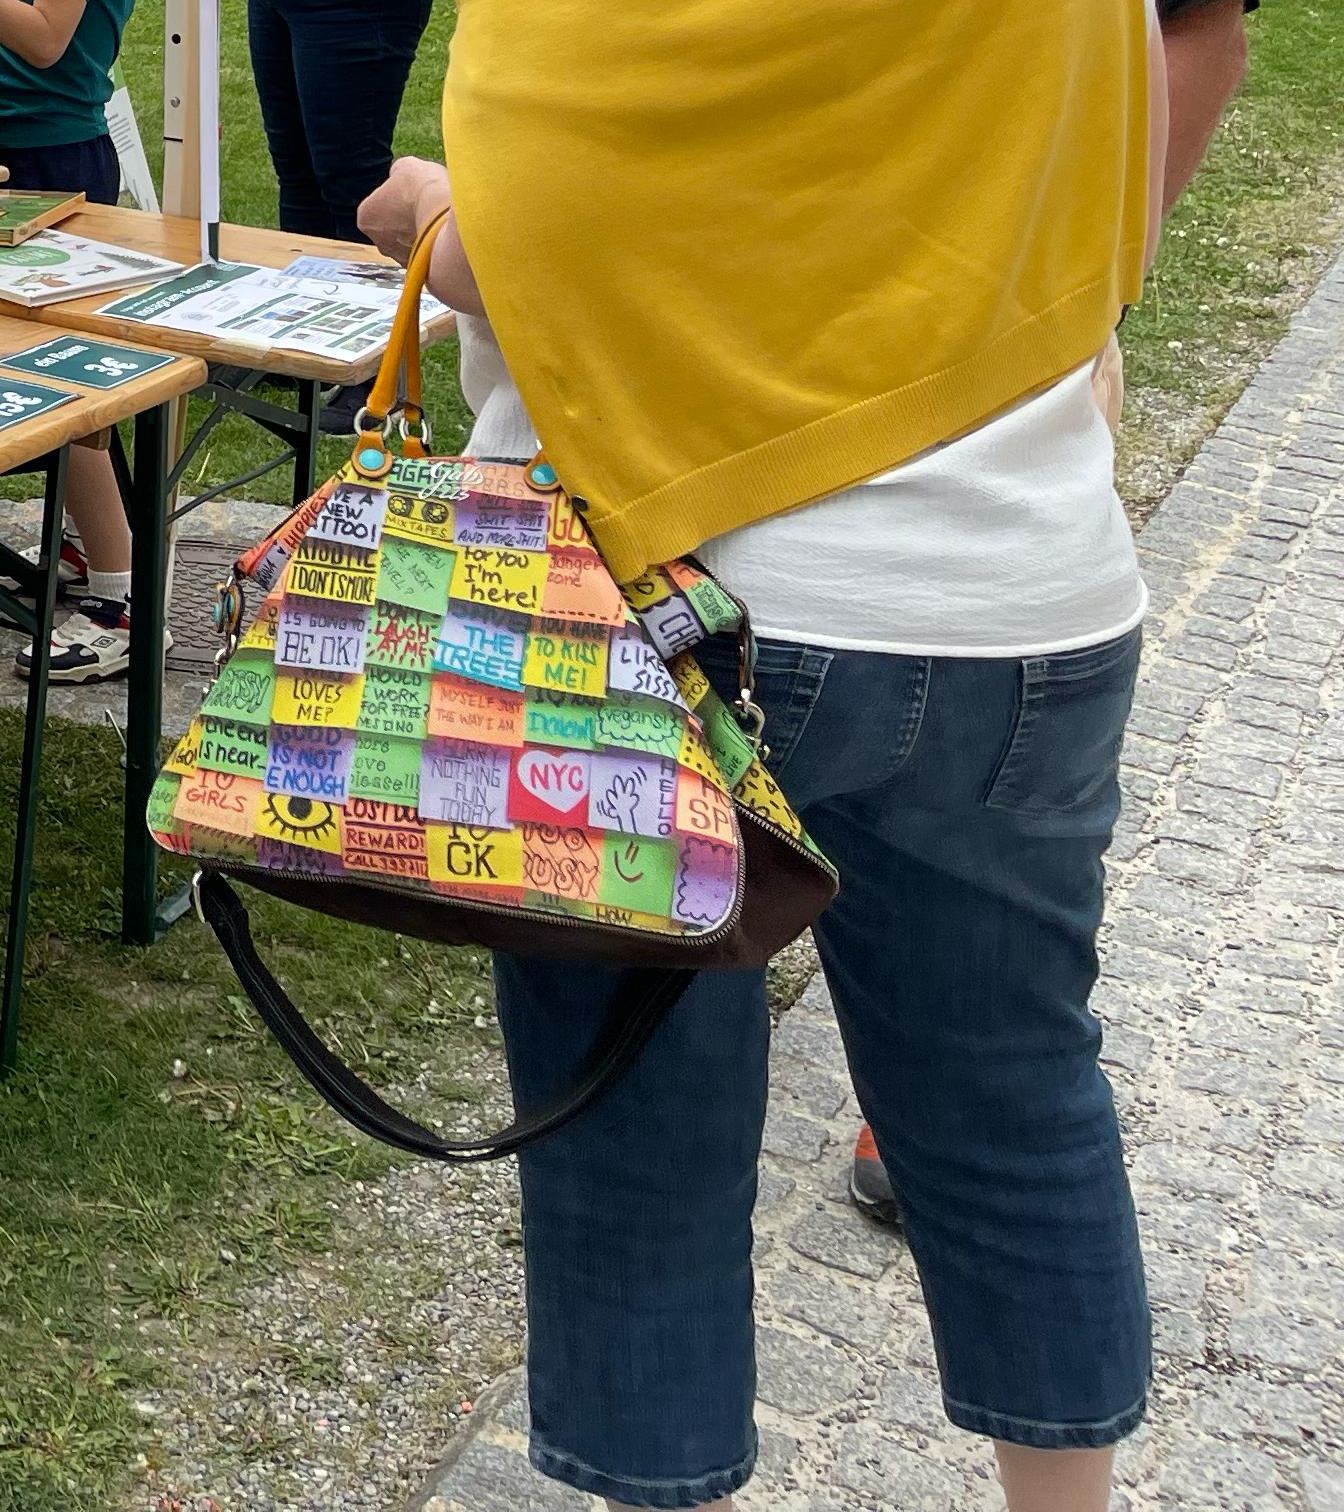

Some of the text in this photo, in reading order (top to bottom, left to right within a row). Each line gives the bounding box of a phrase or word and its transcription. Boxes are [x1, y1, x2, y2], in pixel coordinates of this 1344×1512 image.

[83, 356, 139, 377] 3€
[385, 513, 448, 538] MIXTAPES
[458, 530, 483, 544] AND
[486, 533, 513, 546] MORE
[465, 563, 503, 585] I'm
[336, 574, 376, 603] SMOKE
[470, 583, 537, 608] here!
[283, 611, 302, 626] IS
[373, 620, 431, 641] LAUGH
[280, 631, 360, 666] BE OK!
[376, 636, 429, 659] AT ME
[465, 624, 514, 656] THE
[534, 638, 600, 666] TO KISS
[437, 638, 522, 683] TREES
[544, 663, 587, 689] ME!
[292, 678, 345, 704] LOVES
[373, 688, 420, 704] WORK
[439, 687, 494, 710] MYSELF
[297, 703, 334, 723] ME?
[435, 709, 456, 722] THE
[460, 711, 483, 726] WAY
[497, 718, 515, 734] AM
[271, 745, 342, 771] IS NOT
[267, 766, 345, 796] ENOUGH
[431, 759, 502, 788] NOTHING
[530, 762, 584, 791] NYC
[186, 788, 247, 813] GIRLS
[455, 782, 487, 804] FUN
[440, 797, 497, 825] TODAY
[346, 828, 424, 852] REWARD!
[345, 853, 376, 868] CALL
[447, 842, 498, 879] CK
